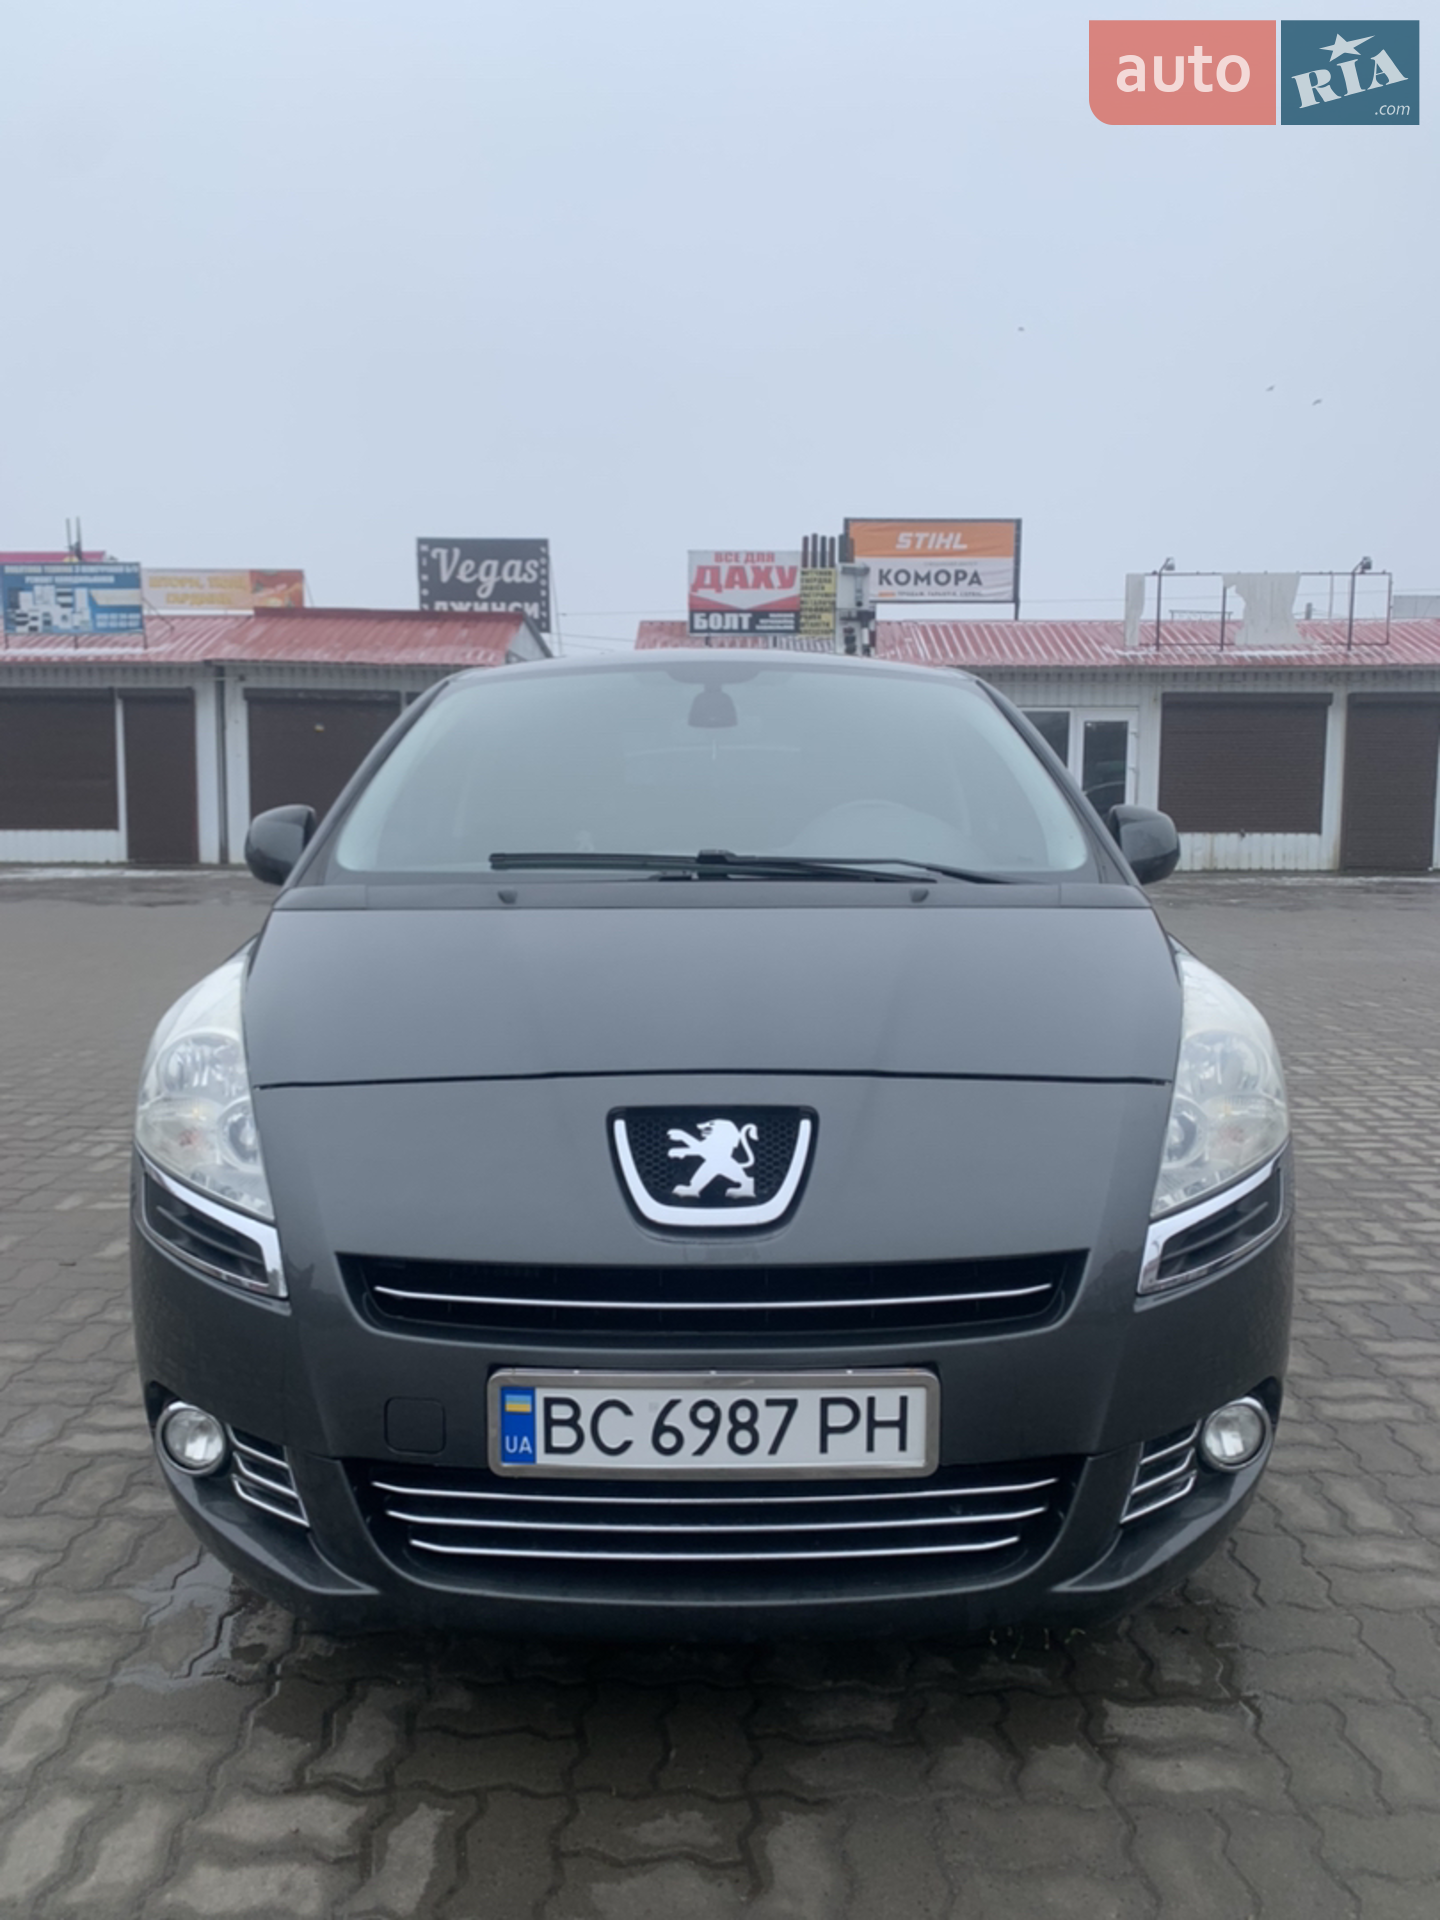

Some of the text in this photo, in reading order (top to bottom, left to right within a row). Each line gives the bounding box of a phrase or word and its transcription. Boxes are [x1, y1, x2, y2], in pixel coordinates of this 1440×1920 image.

[896, 531, 968, 551] STIHL
[714, 551, 775, 564] ВСЕ ДЛЯ
[430, 547, 540, 599] Vegas
[690, 565, 798, 593] ДАХУ
[878, 568, 983, 587] КОМОРА
[693, 612, 753, 631] БОЛТ
[505, 1396, 908, 1457] UA BC 6987 PH
